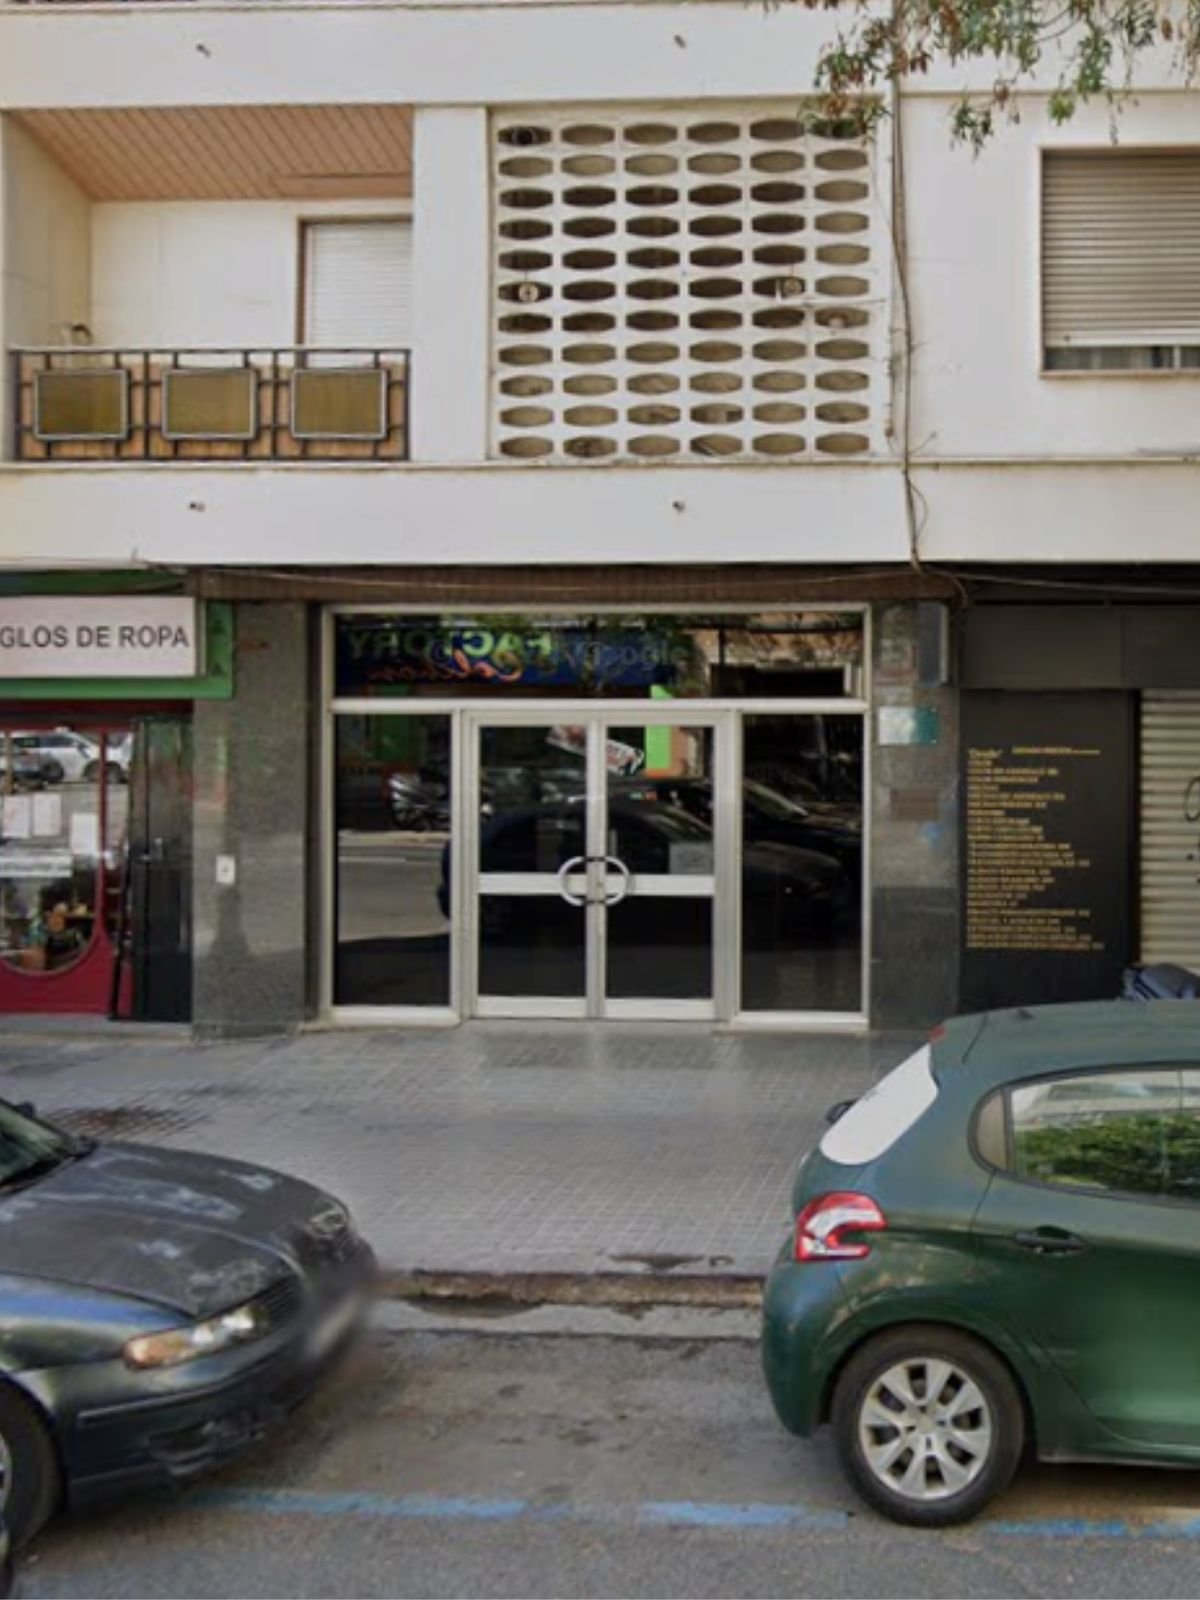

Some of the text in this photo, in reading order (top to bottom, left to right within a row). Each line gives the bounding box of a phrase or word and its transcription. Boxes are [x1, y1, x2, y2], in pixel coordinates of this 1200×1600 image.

[0, 626, 190, 648] GLOS DE ROPA
